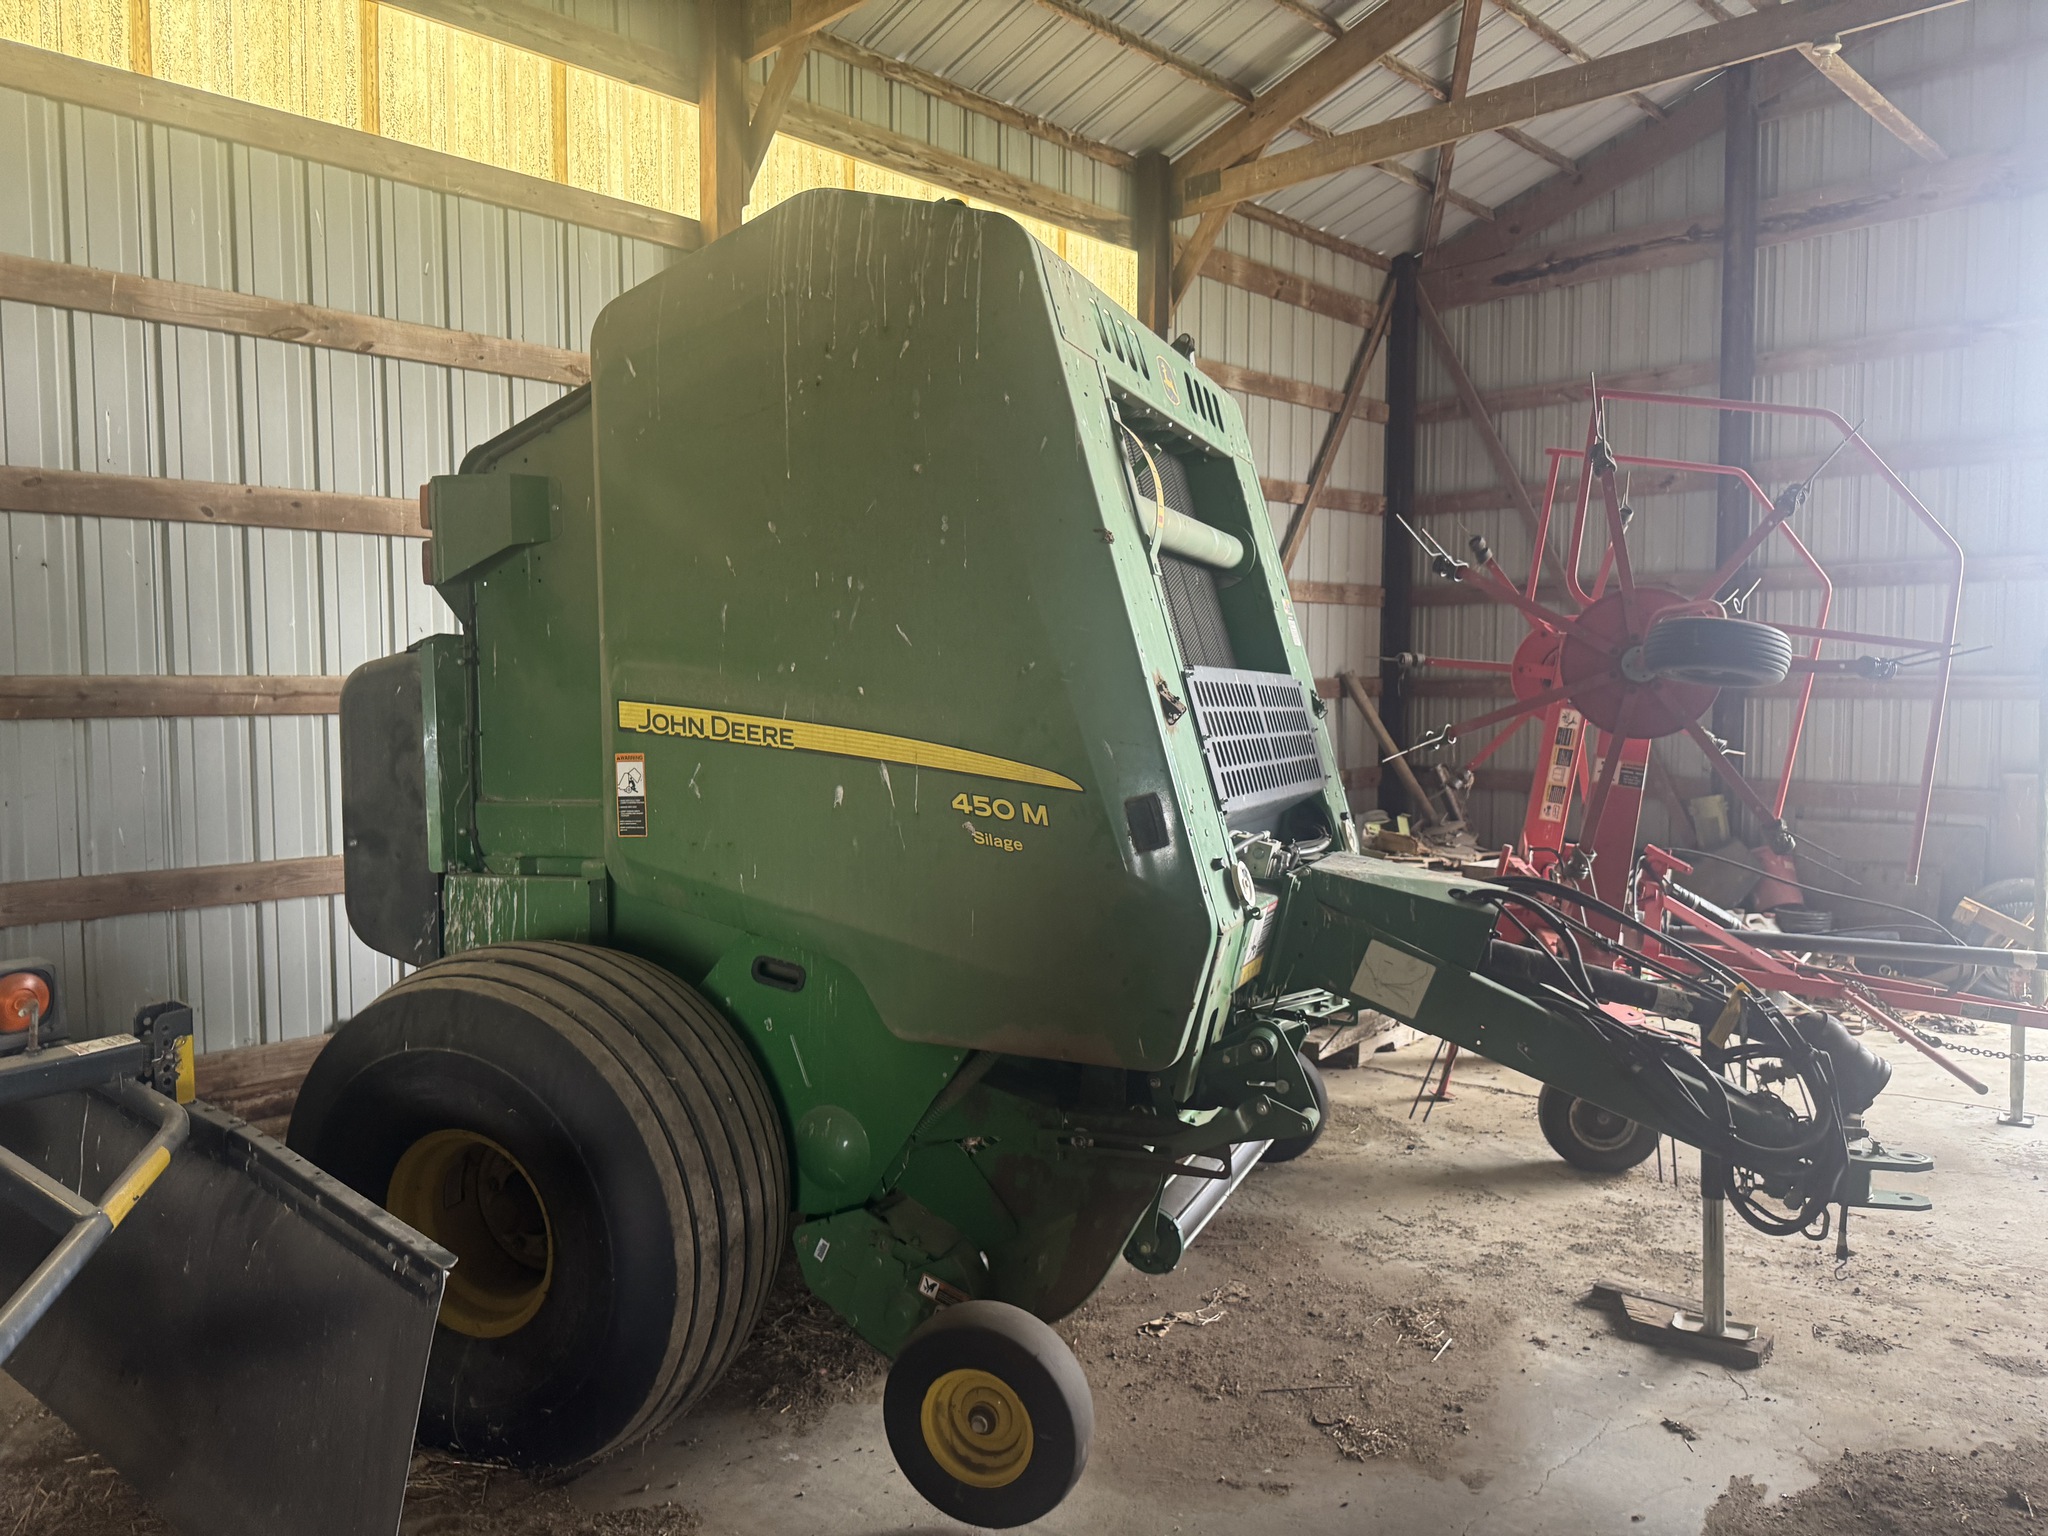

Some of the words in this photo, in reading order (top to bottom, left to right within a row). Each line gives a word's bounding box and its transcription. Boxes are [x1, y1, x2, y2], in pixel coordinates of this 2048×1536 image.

[638, 708, 705, 736] JOHN
[711, 715, 795, 747] DEERE
[951, 793, 1016, 821] 450
[1021, 802, 1049, 827] M
[973, 831, 1024, 852] Silage
